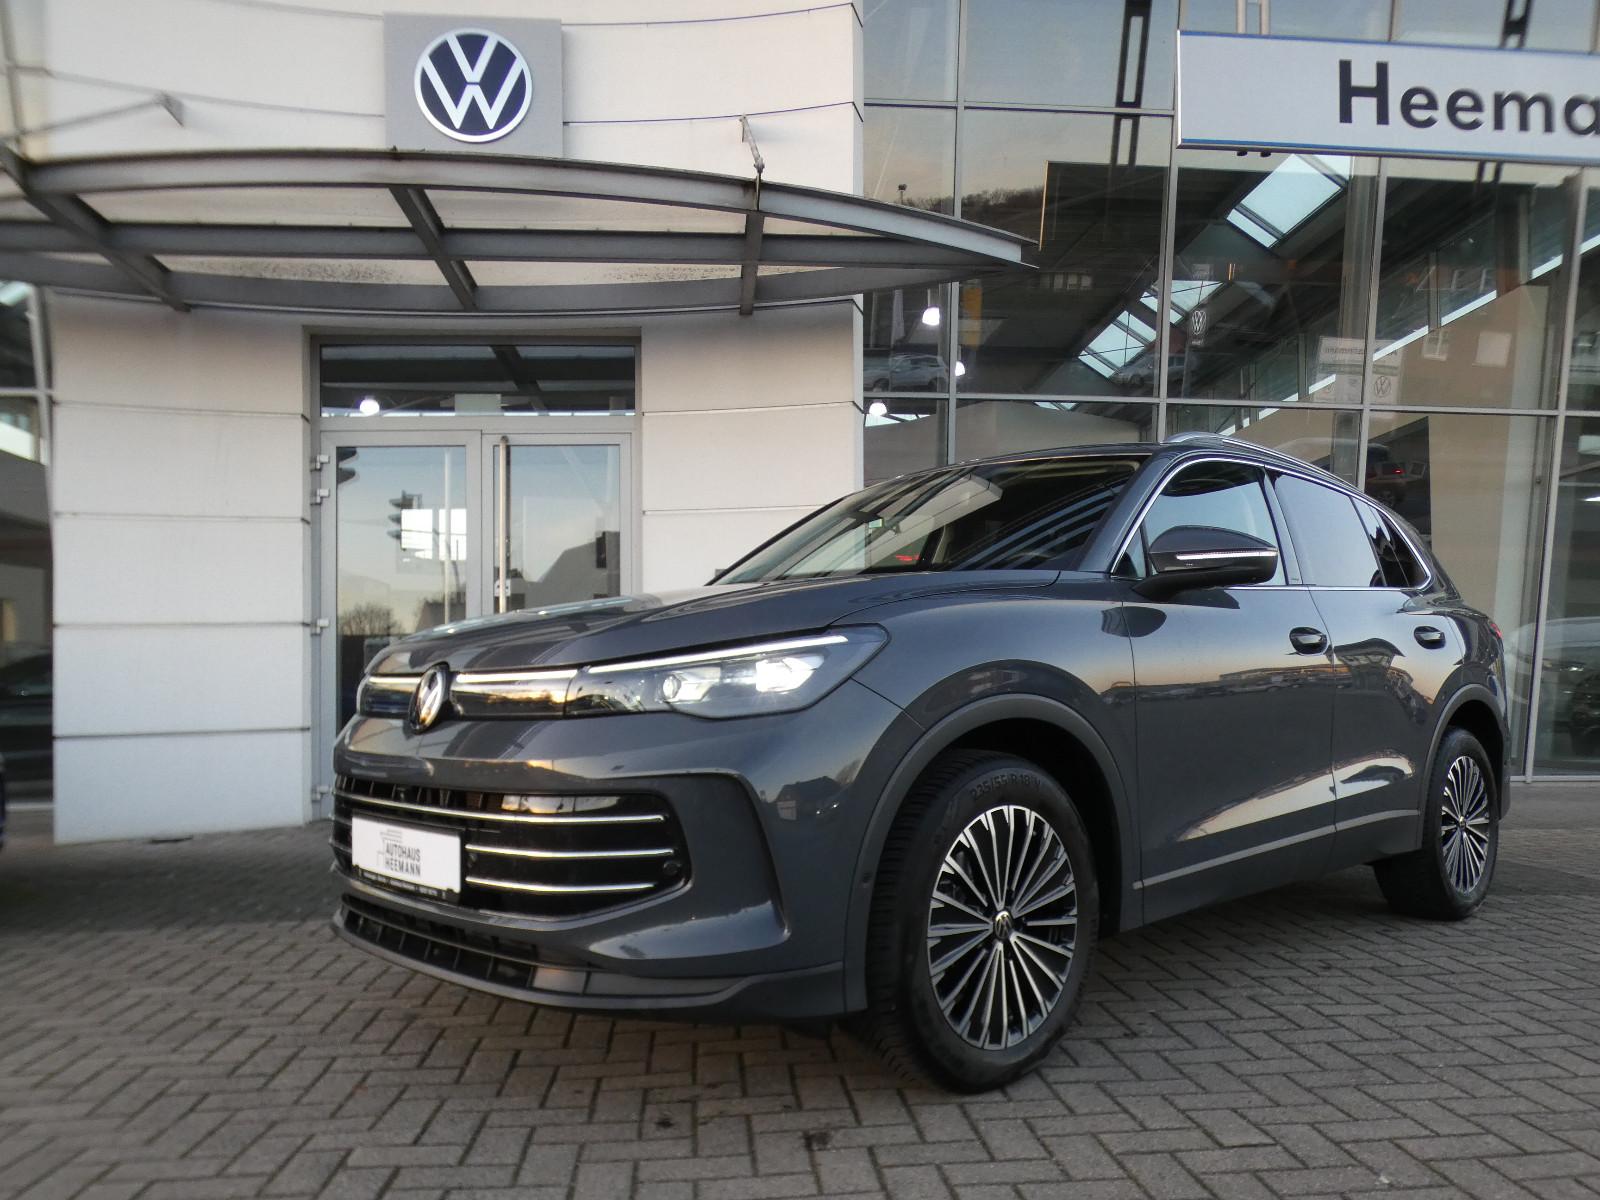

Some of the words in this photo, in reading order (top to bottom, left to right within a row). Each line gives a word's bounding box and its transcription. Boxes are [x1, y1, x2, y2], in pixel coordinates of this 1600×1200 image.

[416, 29, 530, 140] VW
[386, 843, 421, 862] AUTOHAUS
[385, 858, 421, 876] HEEMANN
